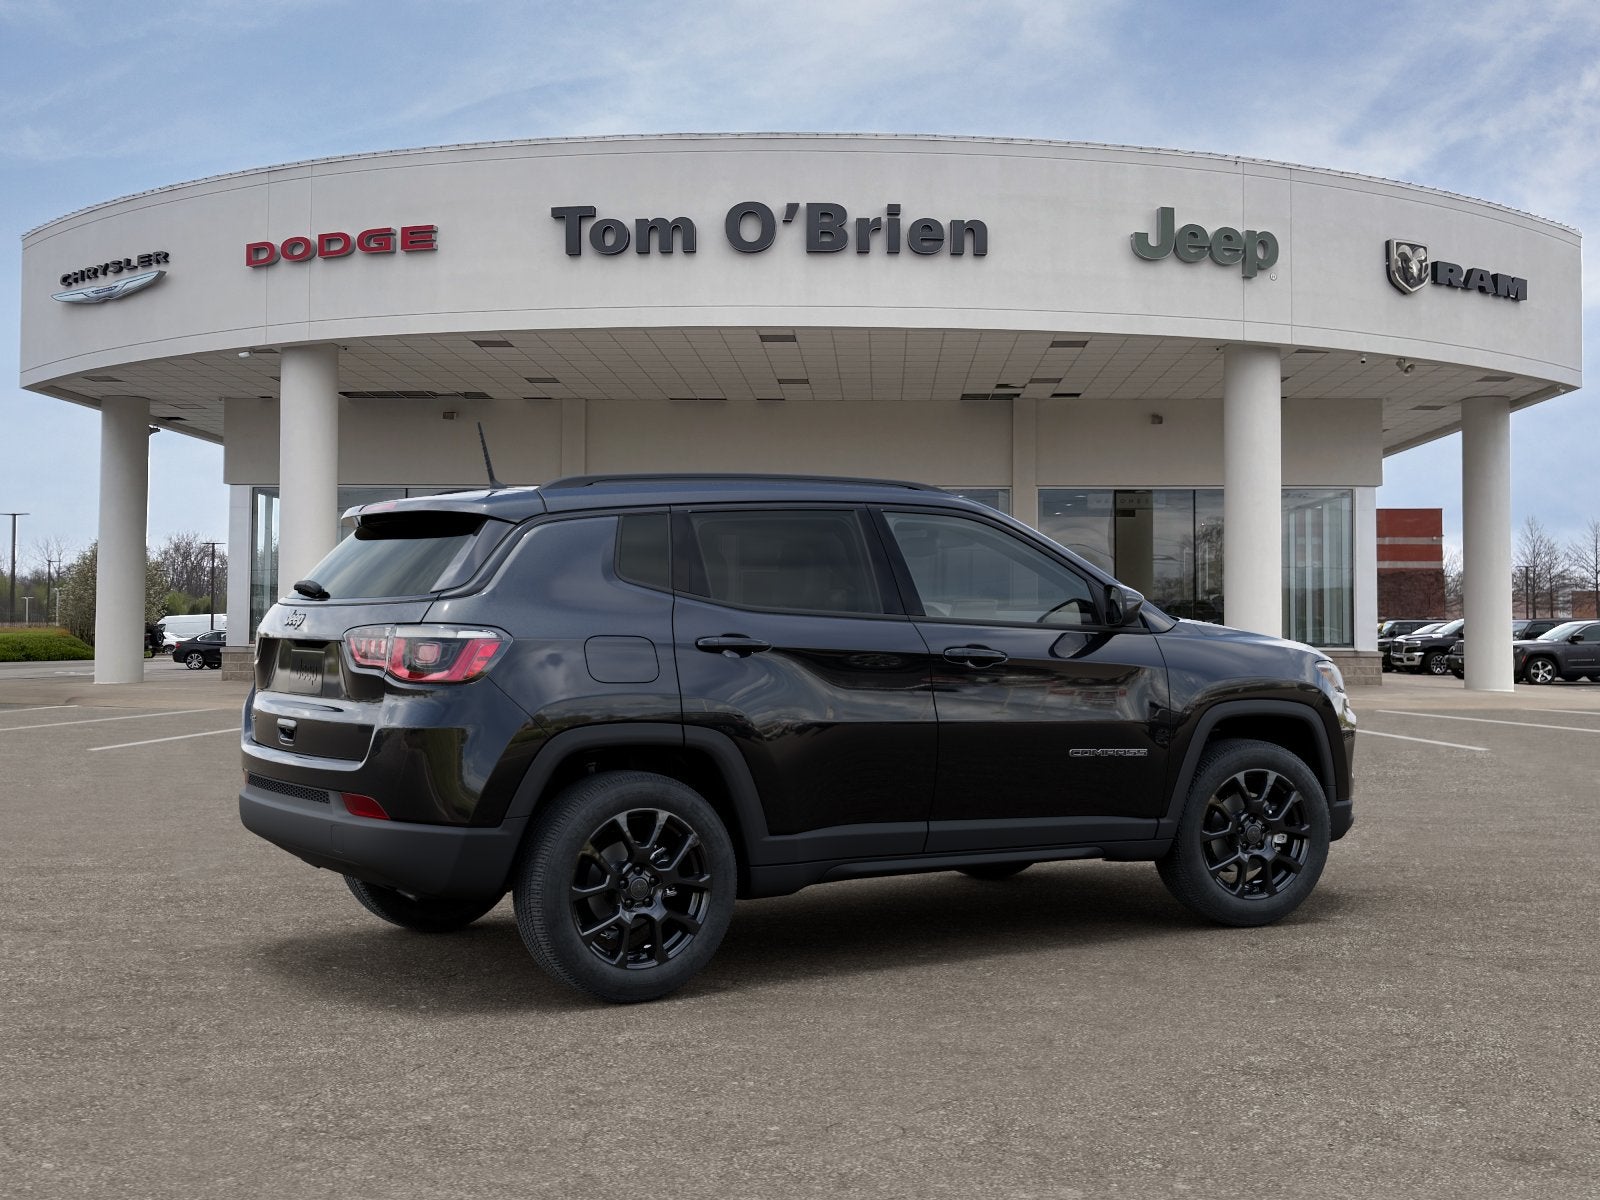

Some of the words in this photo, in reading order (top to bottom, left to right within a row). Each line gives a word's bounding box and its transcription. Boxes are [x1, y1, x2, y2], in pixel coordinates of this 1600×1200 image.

[245, 224, 438, 269] DODGE
[551, 205, 697, 256] Tom
[725, 201, 988, 256] O'Brien
[1131, 206, 1279, 278] Jeep
[60, 250, 170, 287] CHRYSLER
[1431, 260, 1528, 301] RAM
[284, 610, 307, 630] Jeep
[1069, 748, 1148, 757] COMPASS
